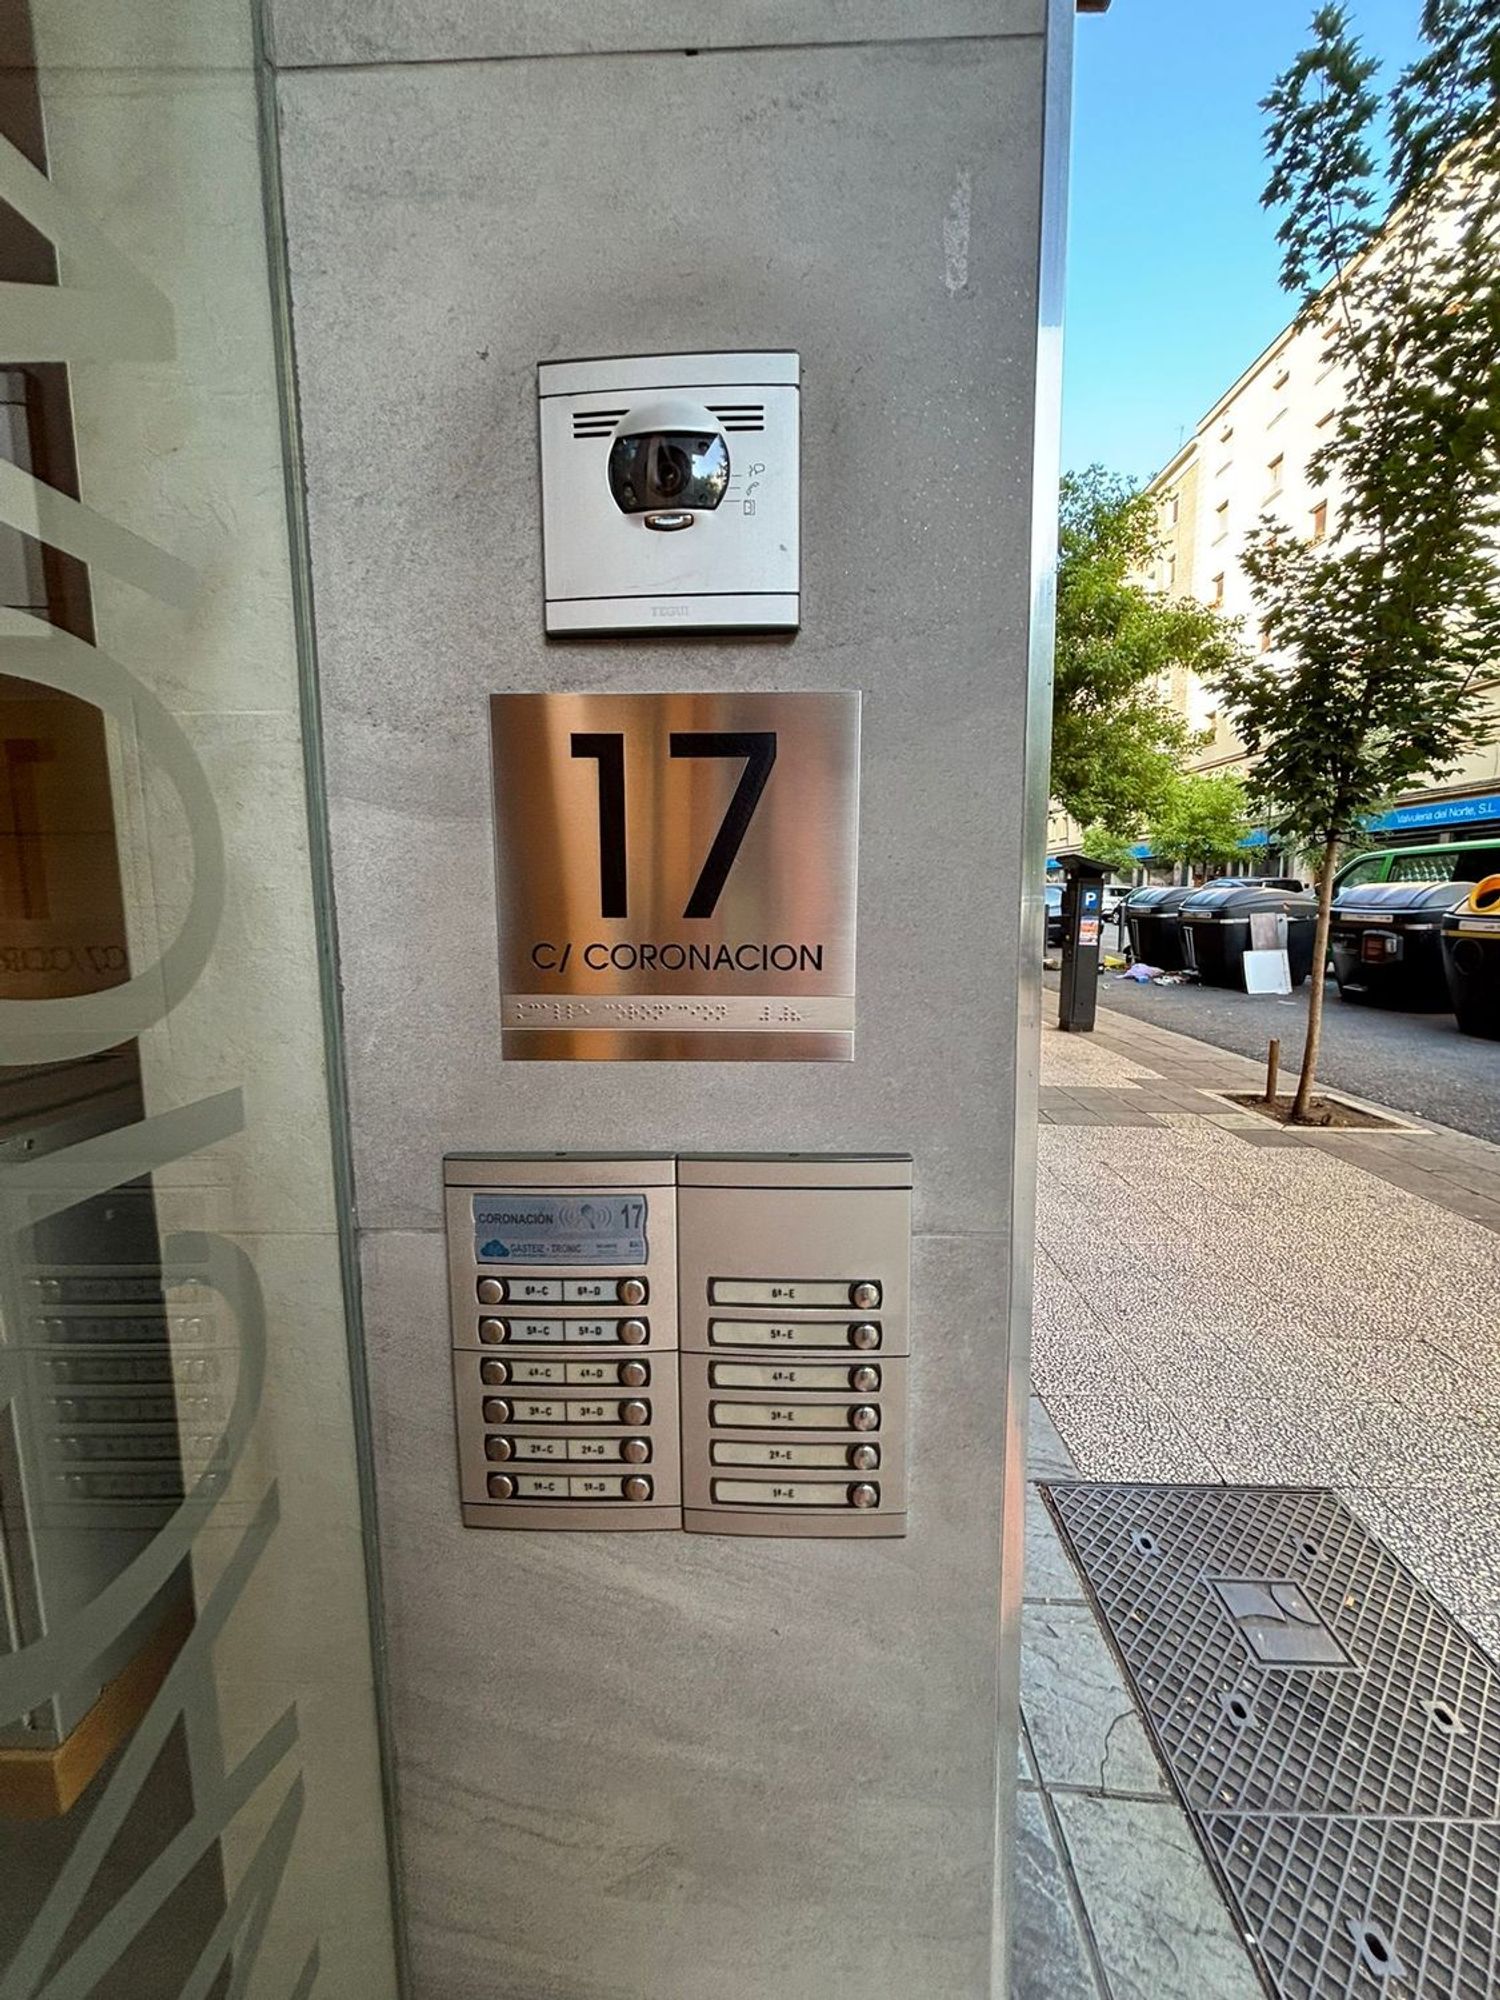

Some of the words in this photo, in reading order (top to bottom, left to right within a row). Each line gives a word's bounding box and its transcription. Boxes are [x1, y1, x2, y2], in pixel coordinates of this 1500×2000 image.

[571, 732, 776, 918] 17
[1085, 892, 1097, 906] P
[532, 943, 571, 972] C/
[584, 944, 822, 970] CORONACION
[621, 1203, 643, 1229] 17
